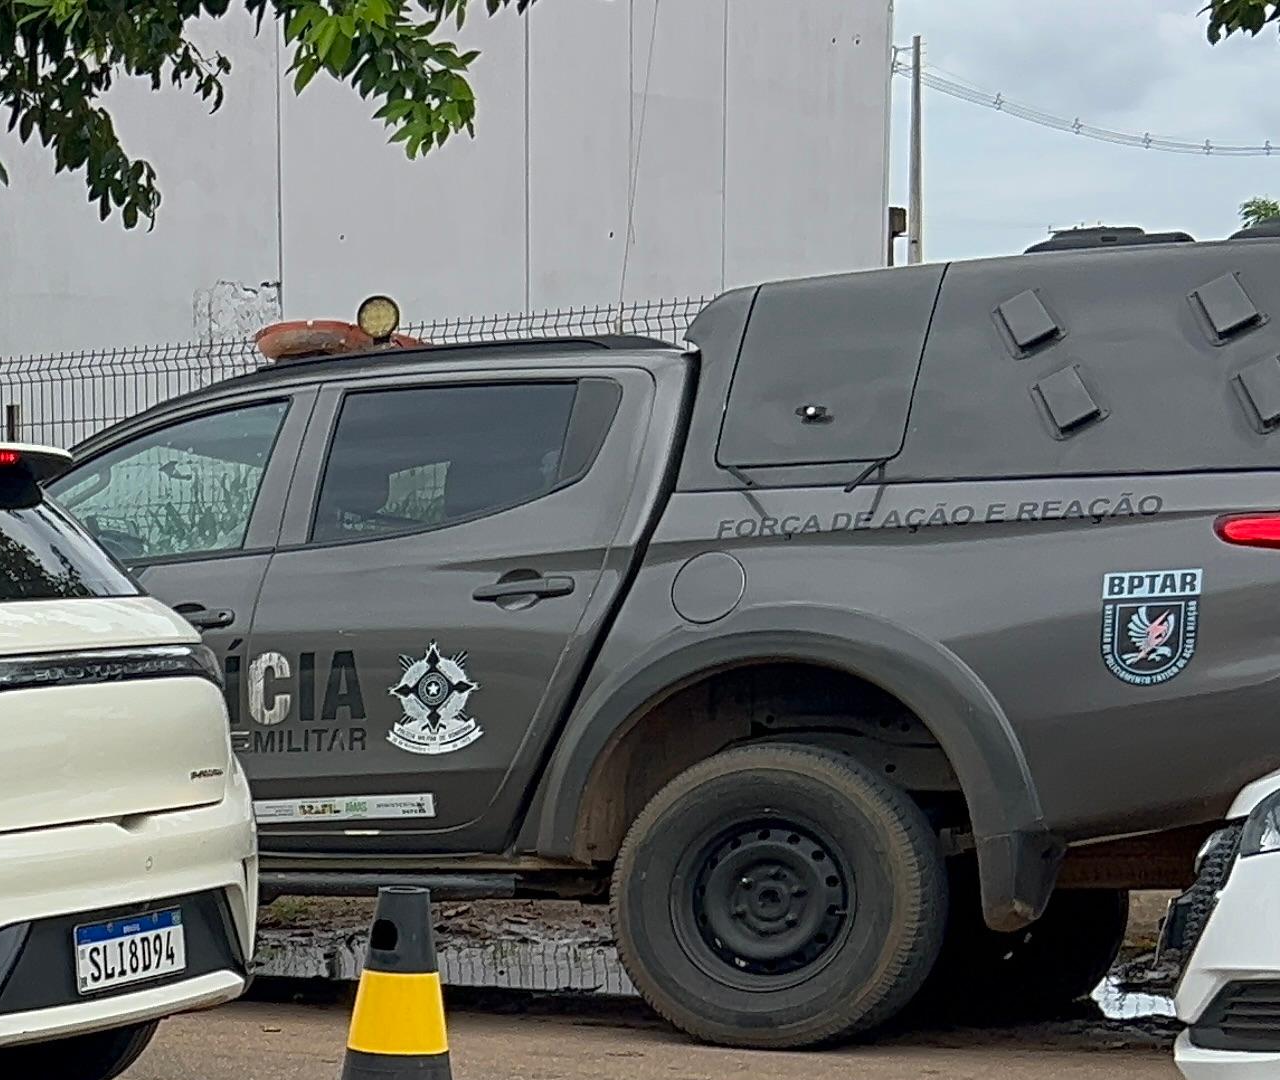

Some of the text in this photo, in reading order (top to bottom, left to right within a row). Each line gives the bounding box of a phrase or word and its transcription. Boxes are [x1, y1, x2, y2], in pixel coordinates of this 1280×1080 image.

[716, 492, 1164, 541] FORÇA DE AÇÃO E REAÇÃO
[1107, 572, 1197, 596] BPTAR
[253, 727, 367, 753] MILITAR
[88, 930, 176, 983] SLI8D94
